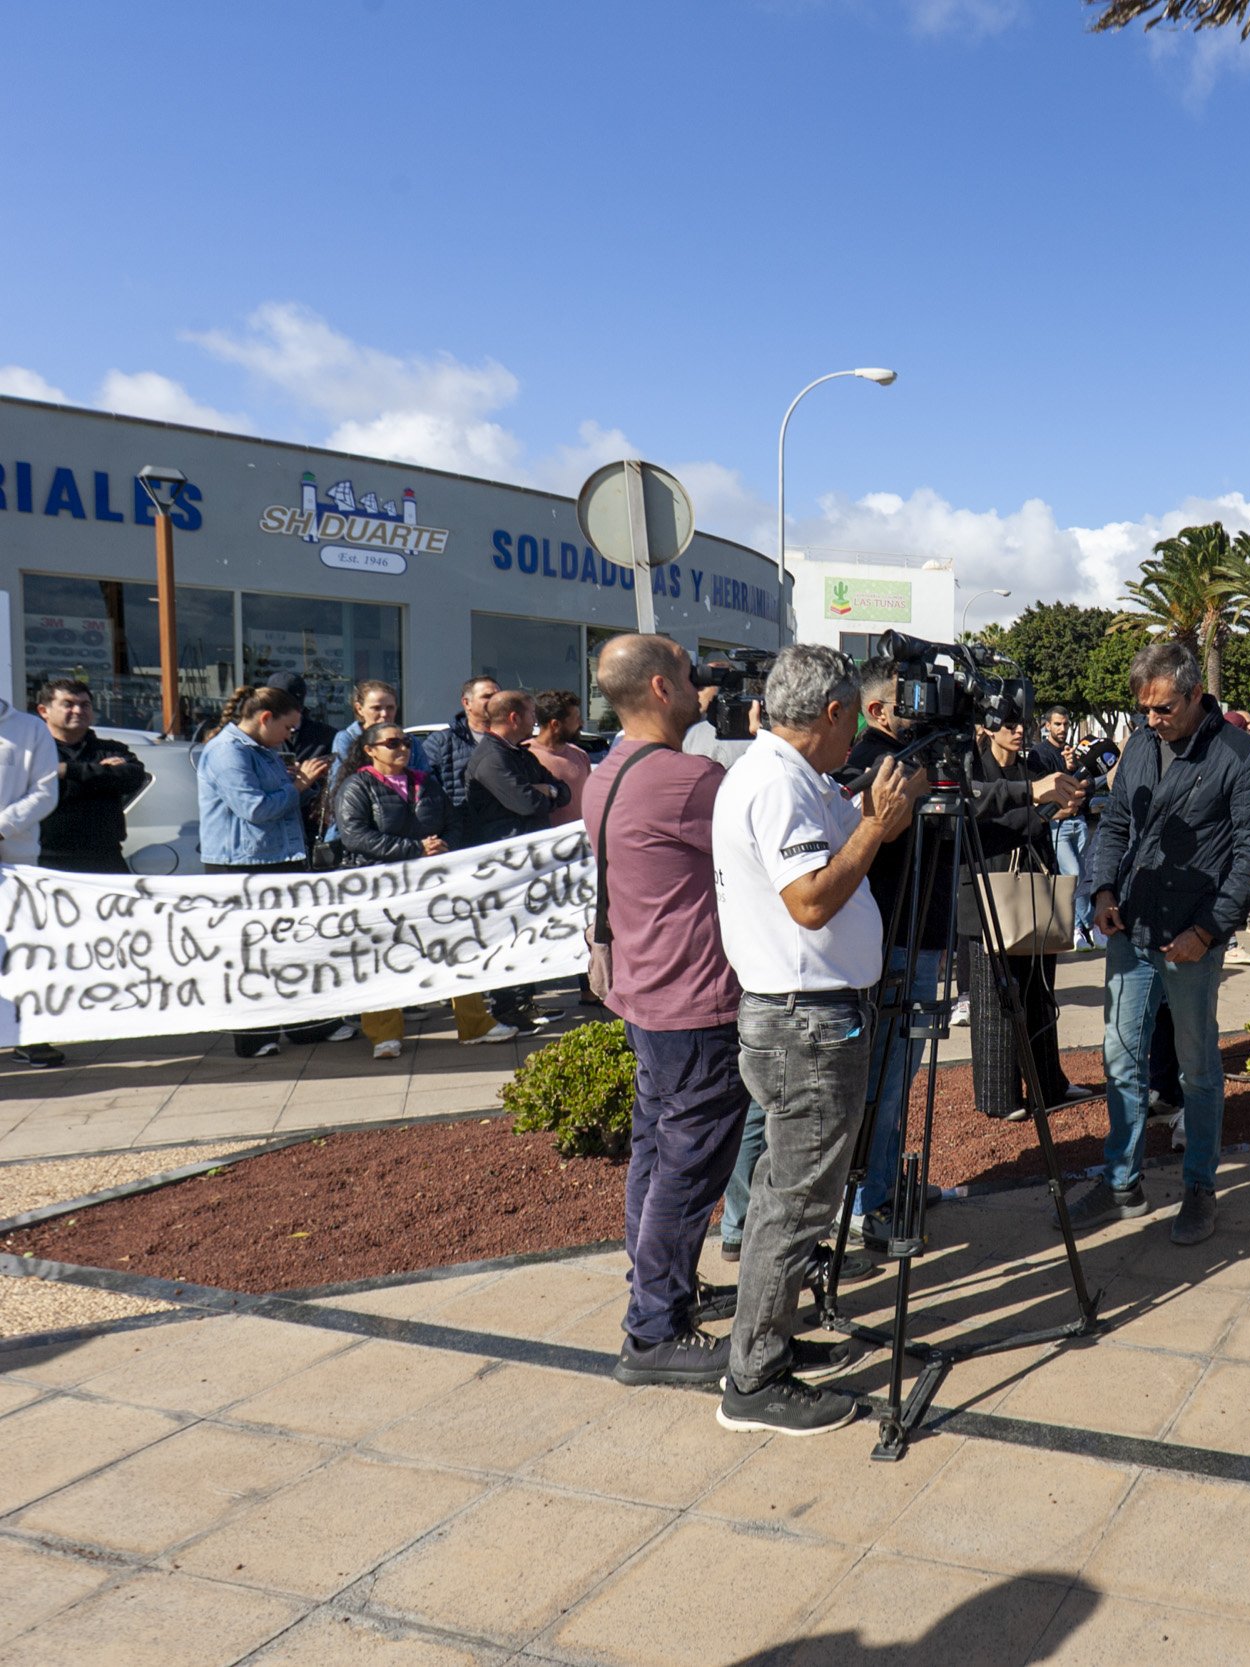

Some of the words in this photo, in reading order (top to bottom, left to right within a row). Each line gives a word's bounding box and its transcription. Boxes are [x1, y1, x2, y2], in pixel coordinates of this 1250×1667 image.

[261, 507, 314, 536] SH
[319, 513, 449, 552] DUARTE
[363, 556, 389, 568] 1946
[492, 529, 681, 598] SOLDADOAS
[690, 568, 704, 602] Y
[853, 598, 871, 607] LAS
[874, 599, 906, 609] TUNAS
[5, 874, 81, 932] No
[0, 929, 152, 976] muere
[167, 912, 221, 966] la
[241, 908, 372, 974] pesca
[14, 970, 206, 1024] nuestra
